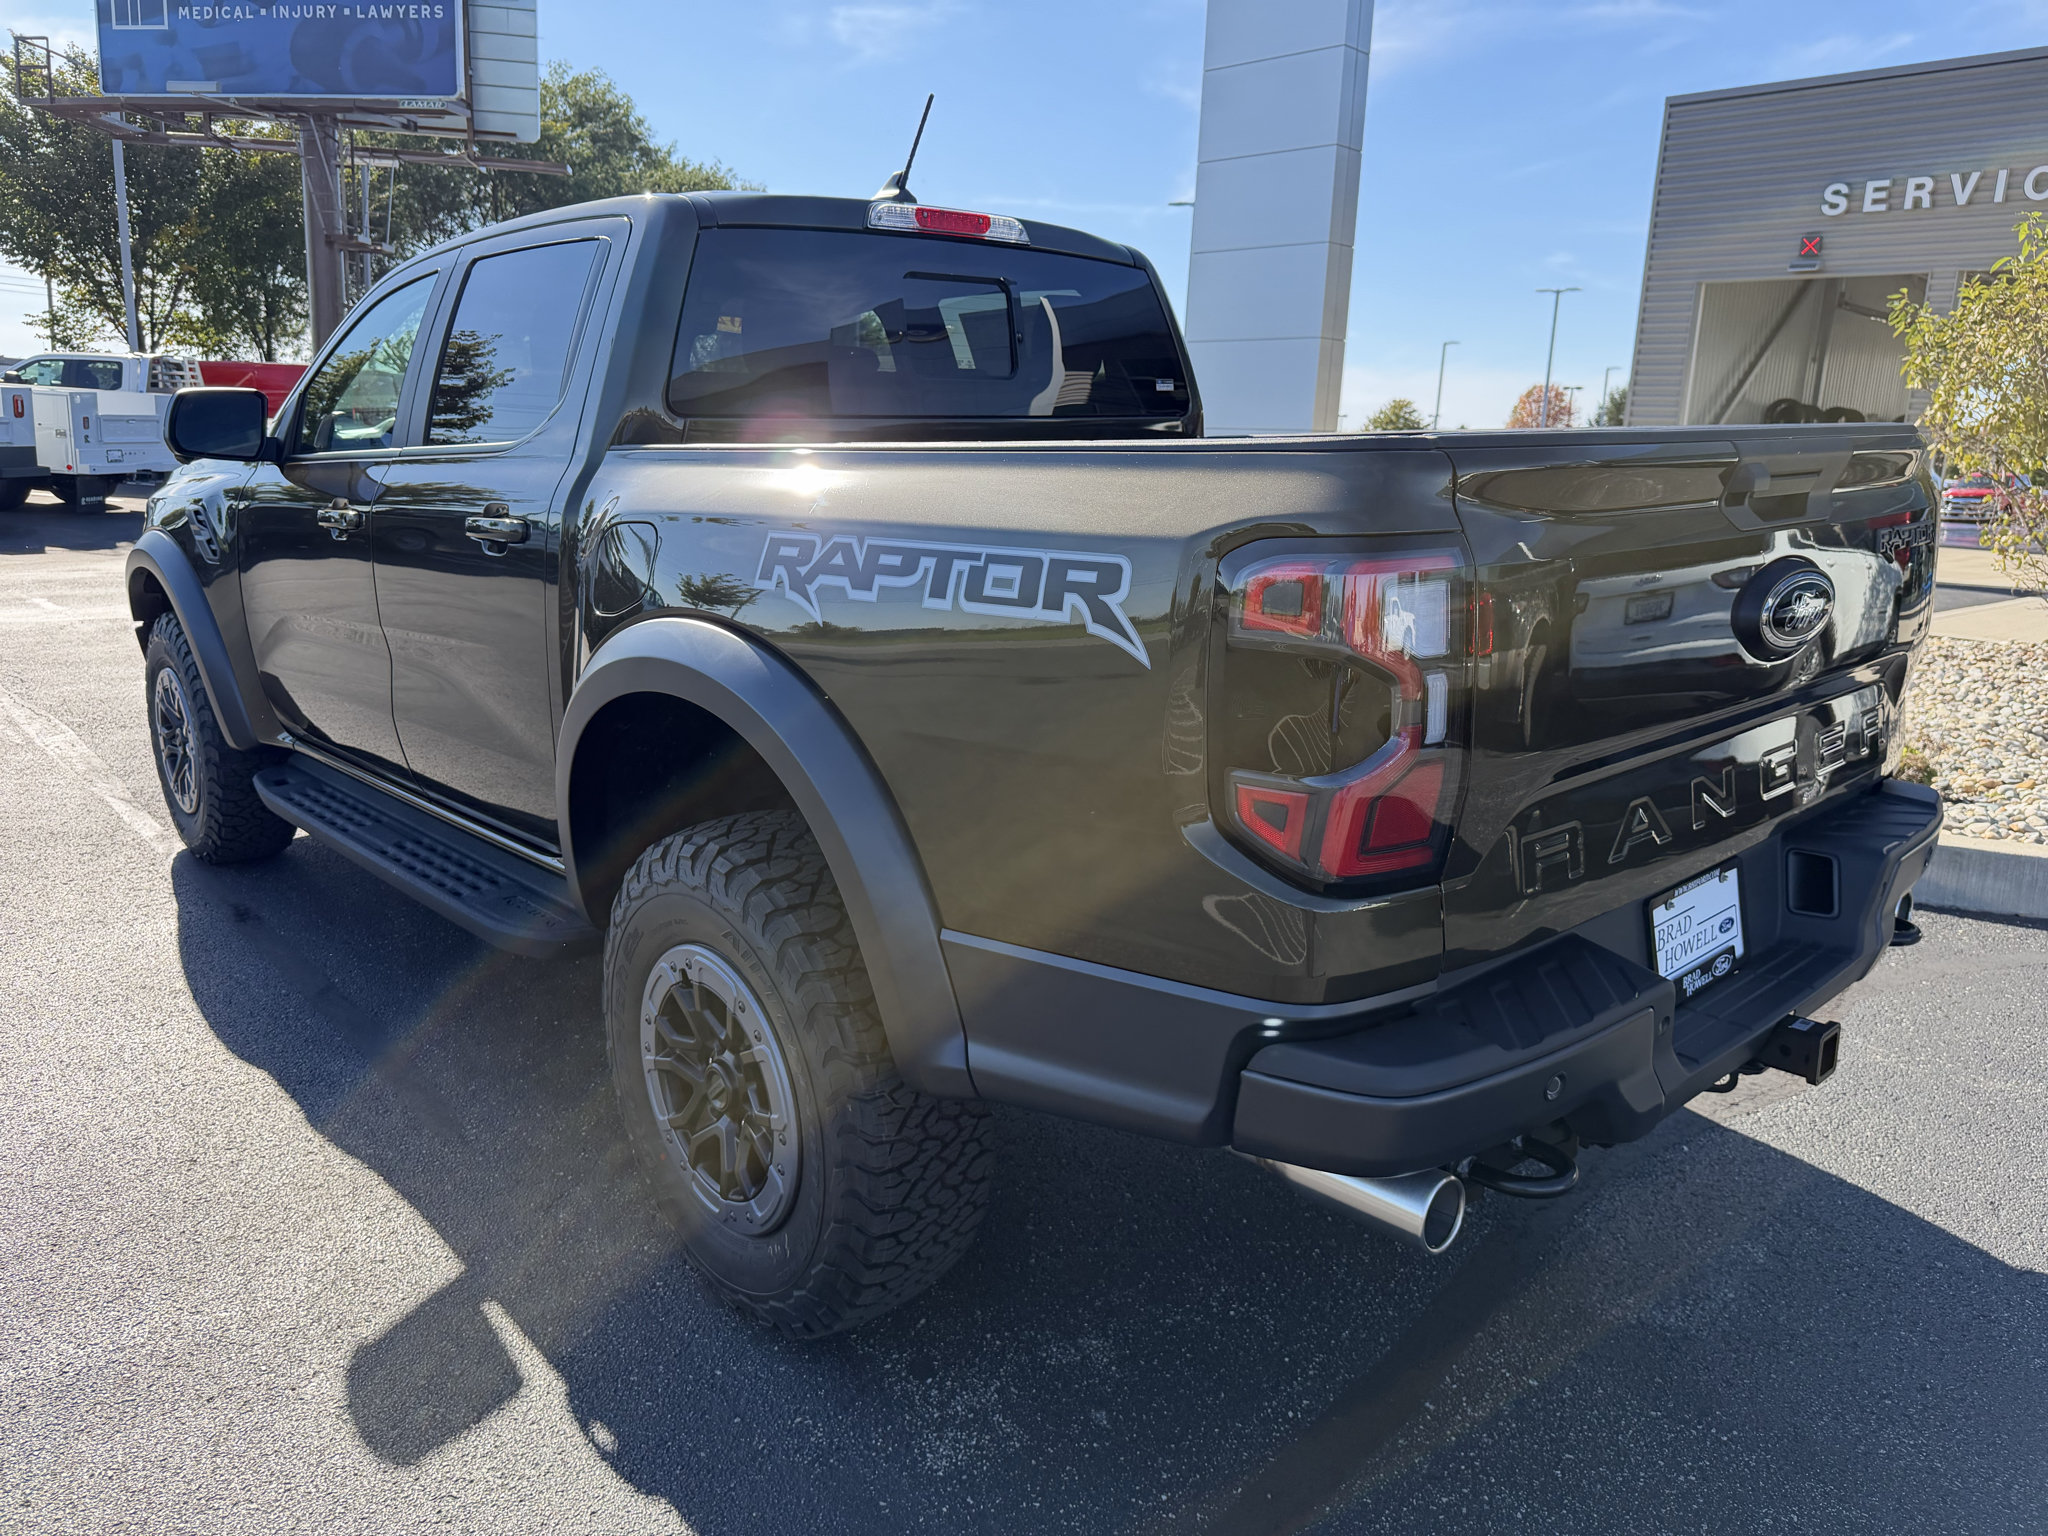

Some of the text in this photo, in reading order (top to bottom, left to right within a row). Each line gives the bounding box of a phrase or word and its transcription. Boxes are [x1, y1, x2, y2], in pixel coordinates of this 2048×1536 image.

[178, 5, 444, 20] MEDICAL INJURY LAWYERS
[753, 530, 1152, 671] RAPTOR
[1520, 704, 1885, 893] RANGER
[1656, 914, 1692, 953] BRAD
[1663, 924, 1718, 973] HOWELL
[1682, 969, 1701, 989] BRAD
[1686, 971, 1714, 997] HOWELL
